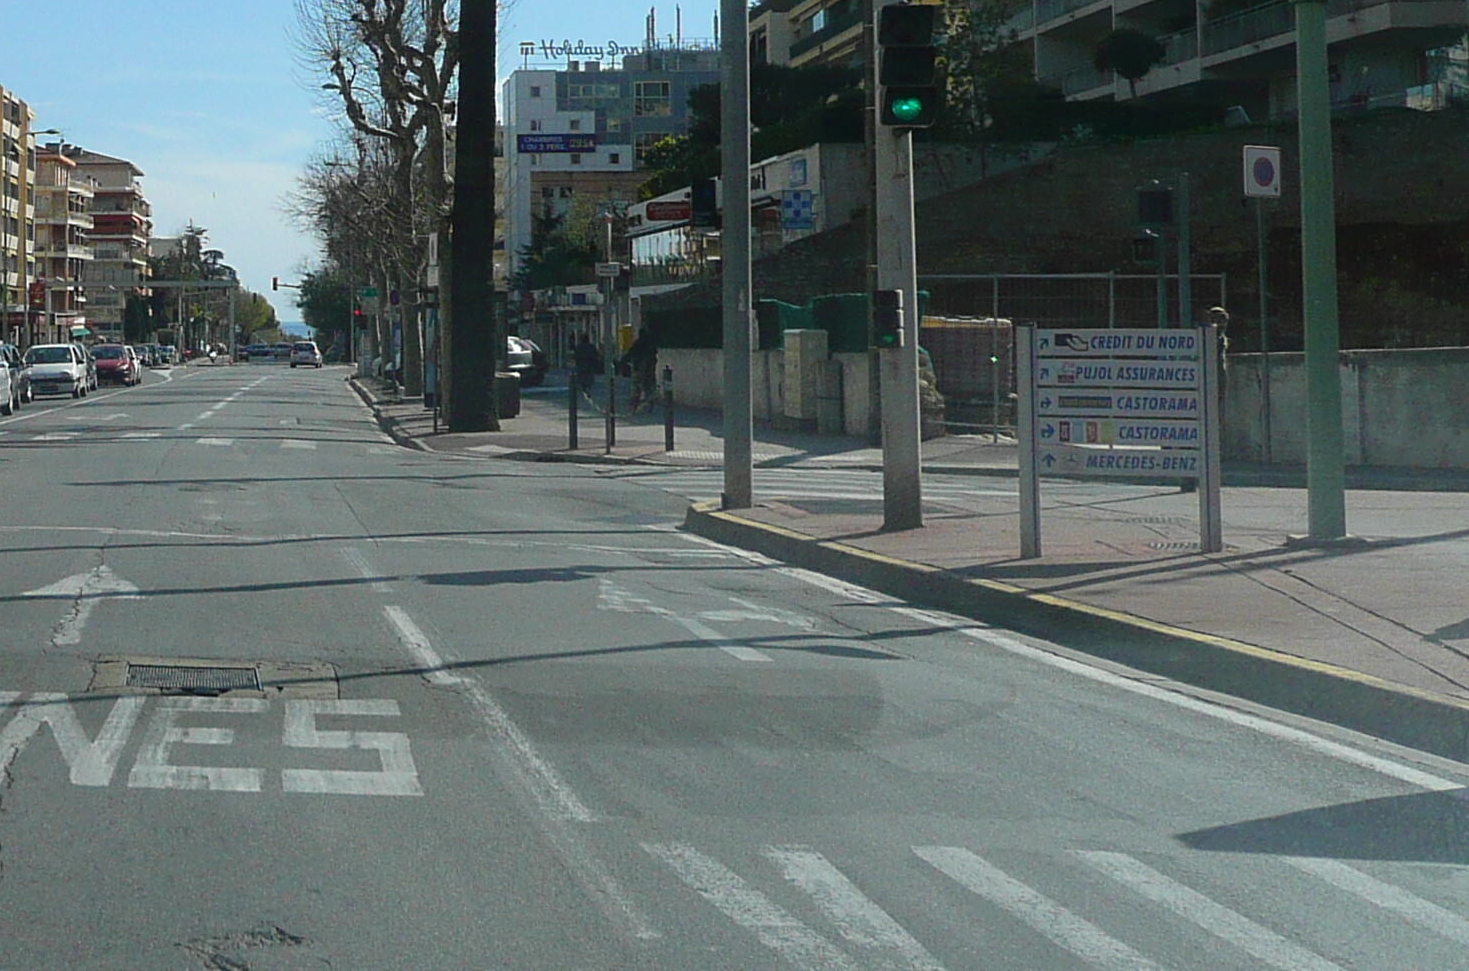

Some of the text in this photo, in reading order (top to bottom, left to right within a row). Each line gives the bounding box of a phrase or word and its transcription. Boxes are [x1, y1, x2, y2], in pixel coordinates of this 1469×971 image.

[539, 39, 604, 60] Holiday
[607, 40, 640, 55] Inn
[1091, 336, 1195, 349] CREDIT DU NORD
[1076, 367, 1112, 380] PUJOL
[1117, 367, 1195, 381] ASSURANCES
[1117, 397, 1197, 411] CASTORAMA
[1119, 426, 1198, 440] CASTORAMA
[1086, 456, 1197, 470] MERCEDES-BENZ
